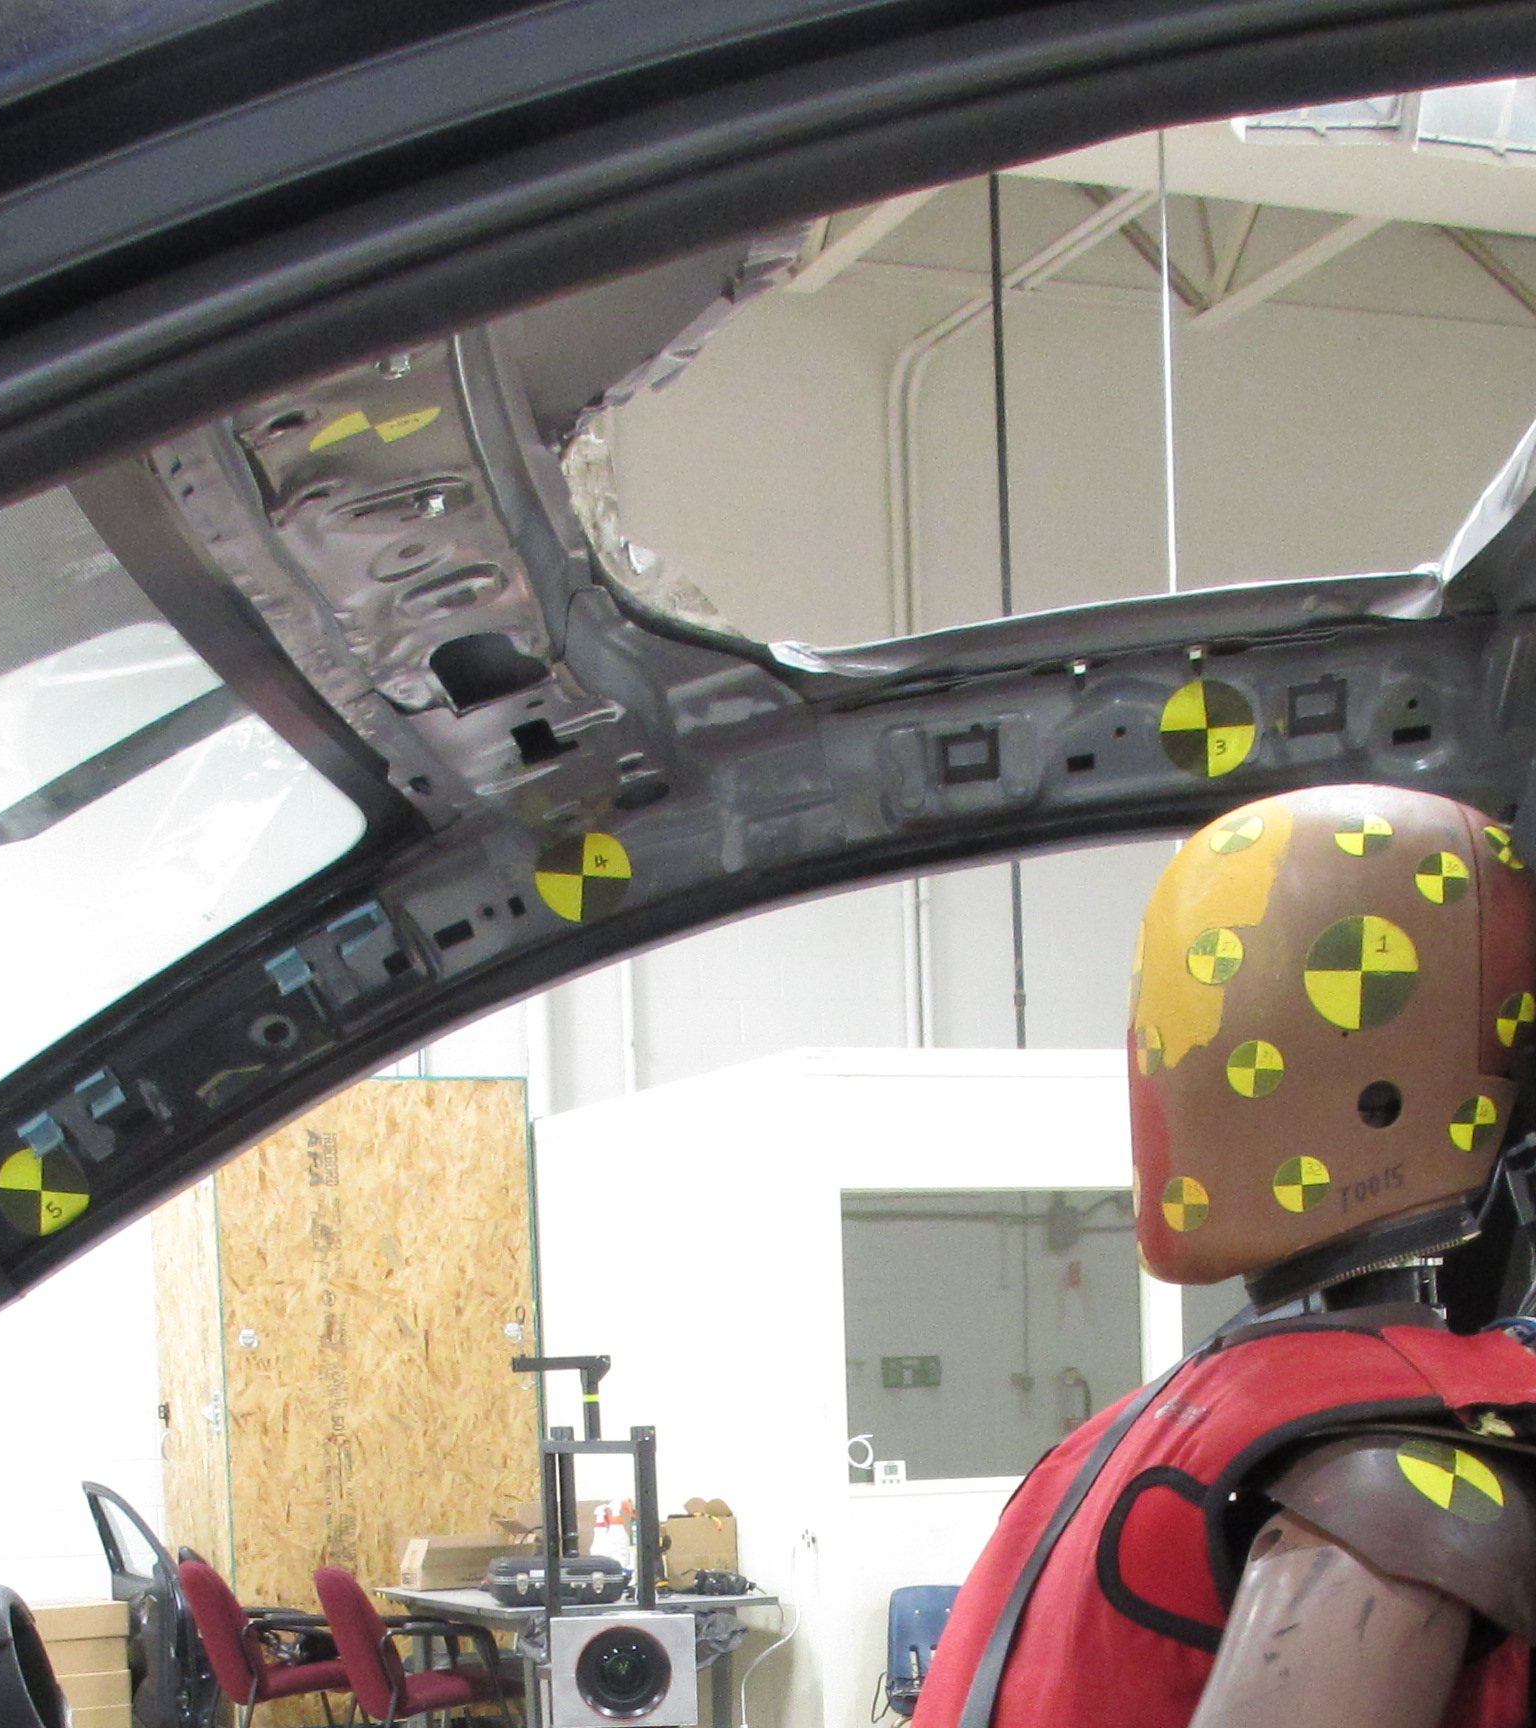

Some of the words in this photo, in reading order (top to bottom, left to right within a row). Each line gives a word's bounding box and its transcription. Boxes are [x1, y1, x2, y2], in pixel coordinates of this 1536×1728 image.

[1214, 739, 1227, 756] 3
[593, 853, 608, 869] 4
[1374, 934, 1390, 953] 1
[45, 1201, 63, 1219] 5
